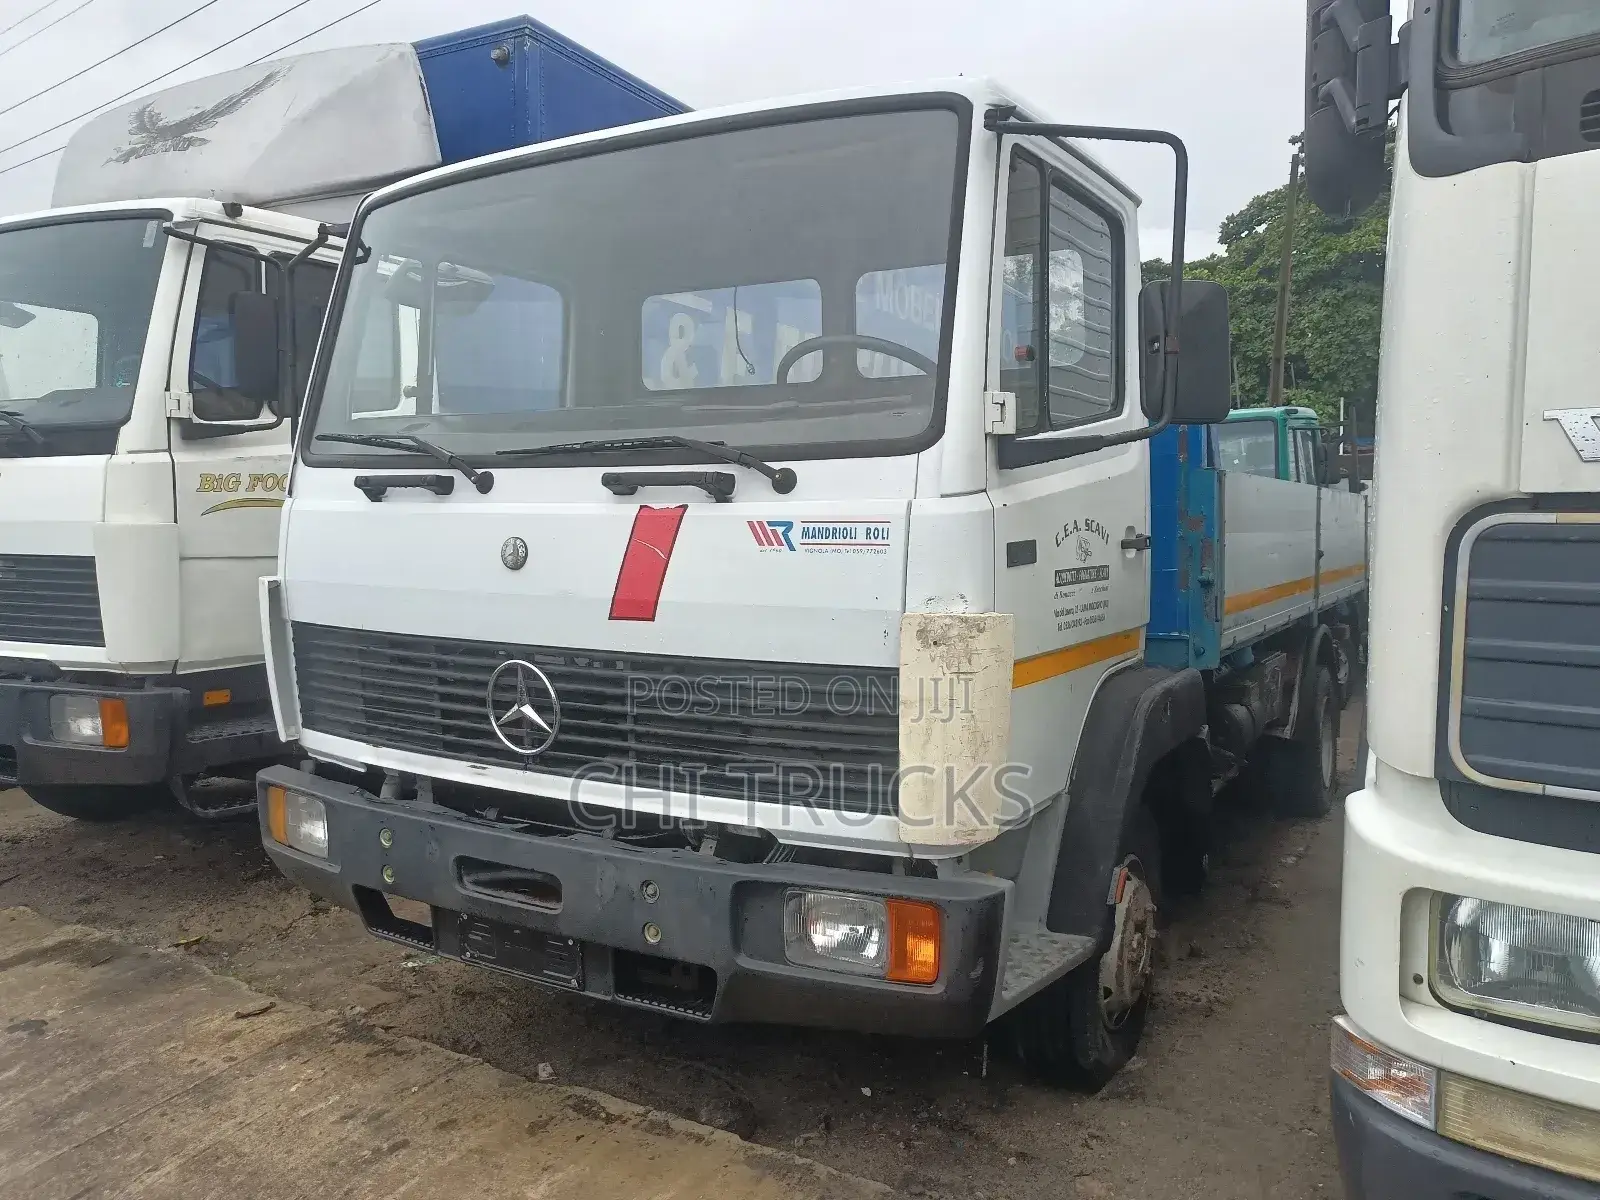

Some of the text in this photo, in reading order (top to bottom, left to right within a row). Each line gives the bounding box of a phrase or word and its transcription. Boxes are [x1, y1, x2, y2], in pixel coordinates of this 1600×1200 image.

[801, 526, 858, 540] MANDRIOLI
[865, 526, 890, 540] ROLI
[1085, 518, 1109, 545] SCAVI
